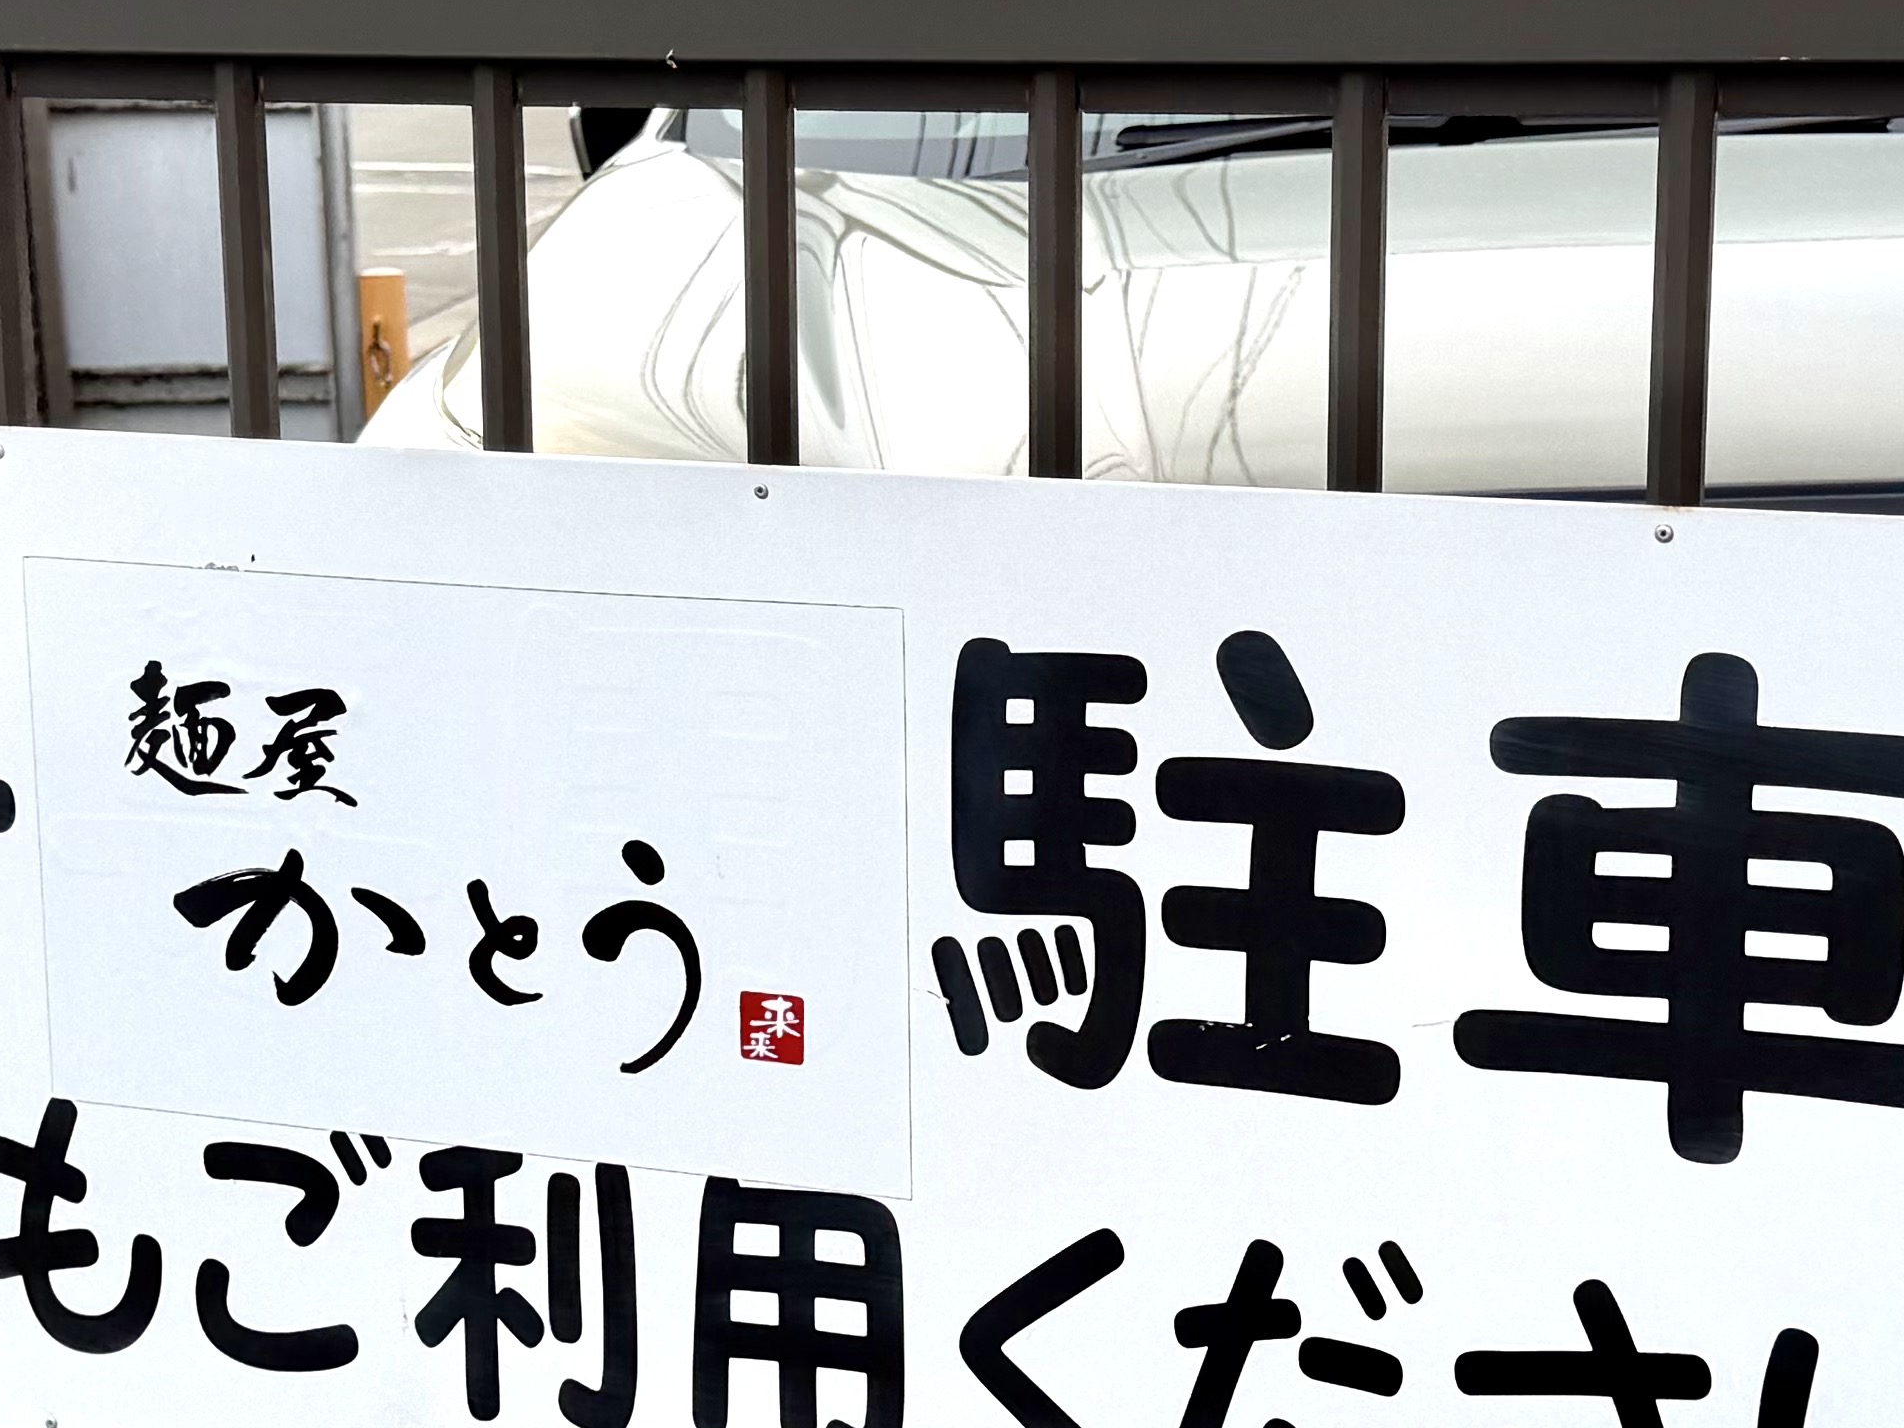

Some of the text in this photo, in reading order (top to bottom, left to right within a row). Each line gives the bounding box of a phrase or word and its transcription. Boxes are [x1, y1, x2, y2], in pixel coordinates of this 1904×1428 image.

[125, 661, 357, 807] 麺屋
[174, 849, 701, 1073] かとう
